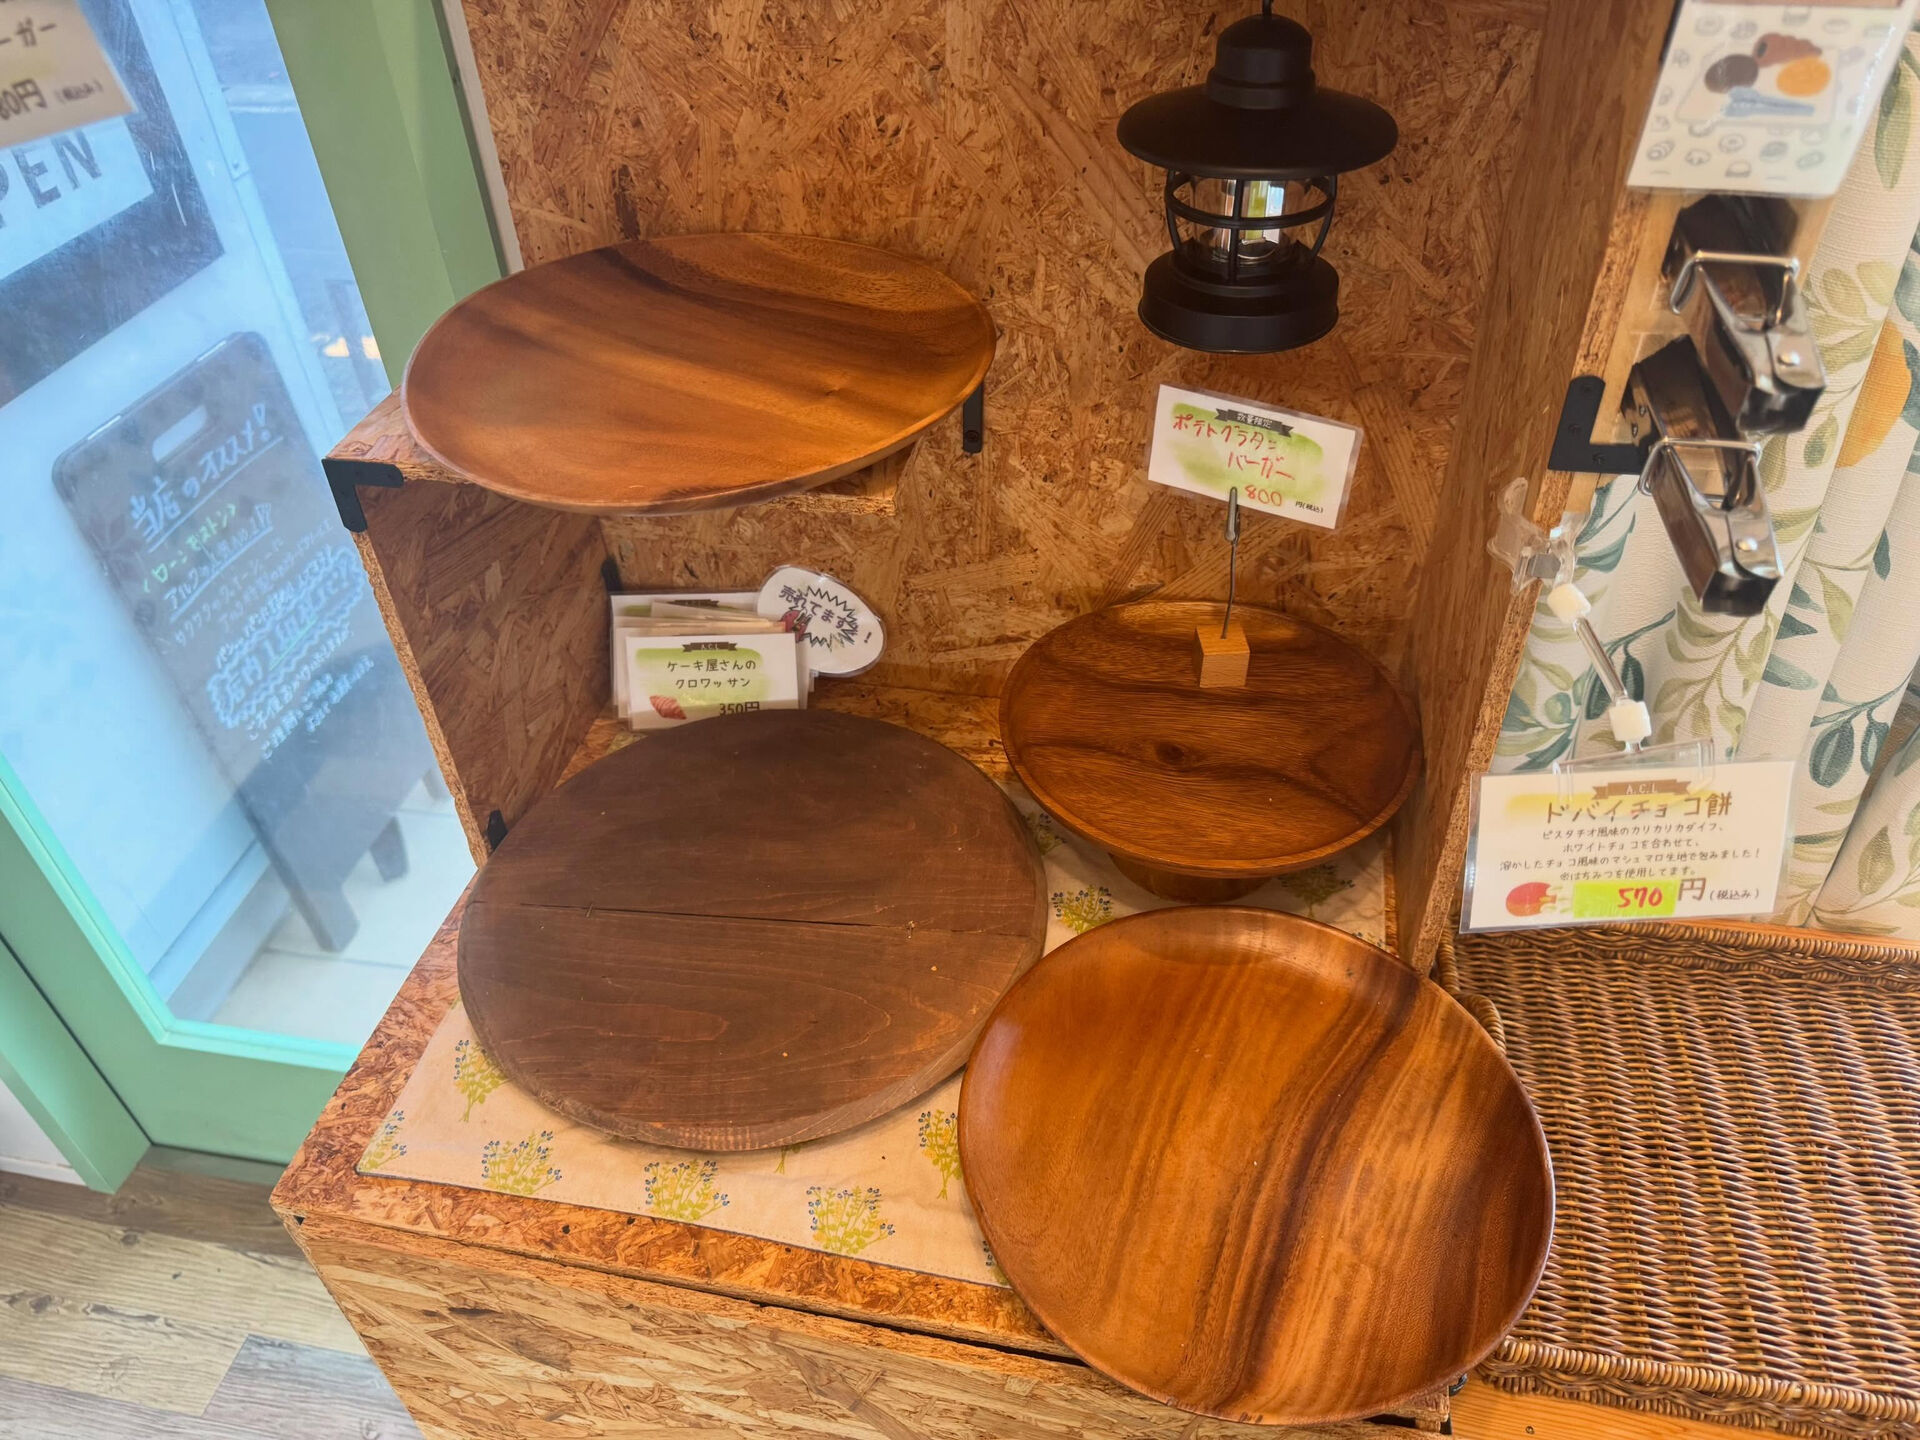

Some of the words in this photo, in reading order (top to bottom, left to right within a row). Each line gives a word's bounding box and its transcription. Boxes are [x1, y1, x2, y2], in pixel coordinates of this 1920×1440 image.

[1228, 452, 1295, 480] バーガー
[1245, 484, 1282, 506] 800
[667, 659, 756, 672] ケーキ屋さんの
[675, 678, 751, 689] クロワッサン
[719, 701, 760, 716] 350円
[1547, 791, 1732, 824] ドバイチョコ餅
[1617, 886, 1663, 908] 570
